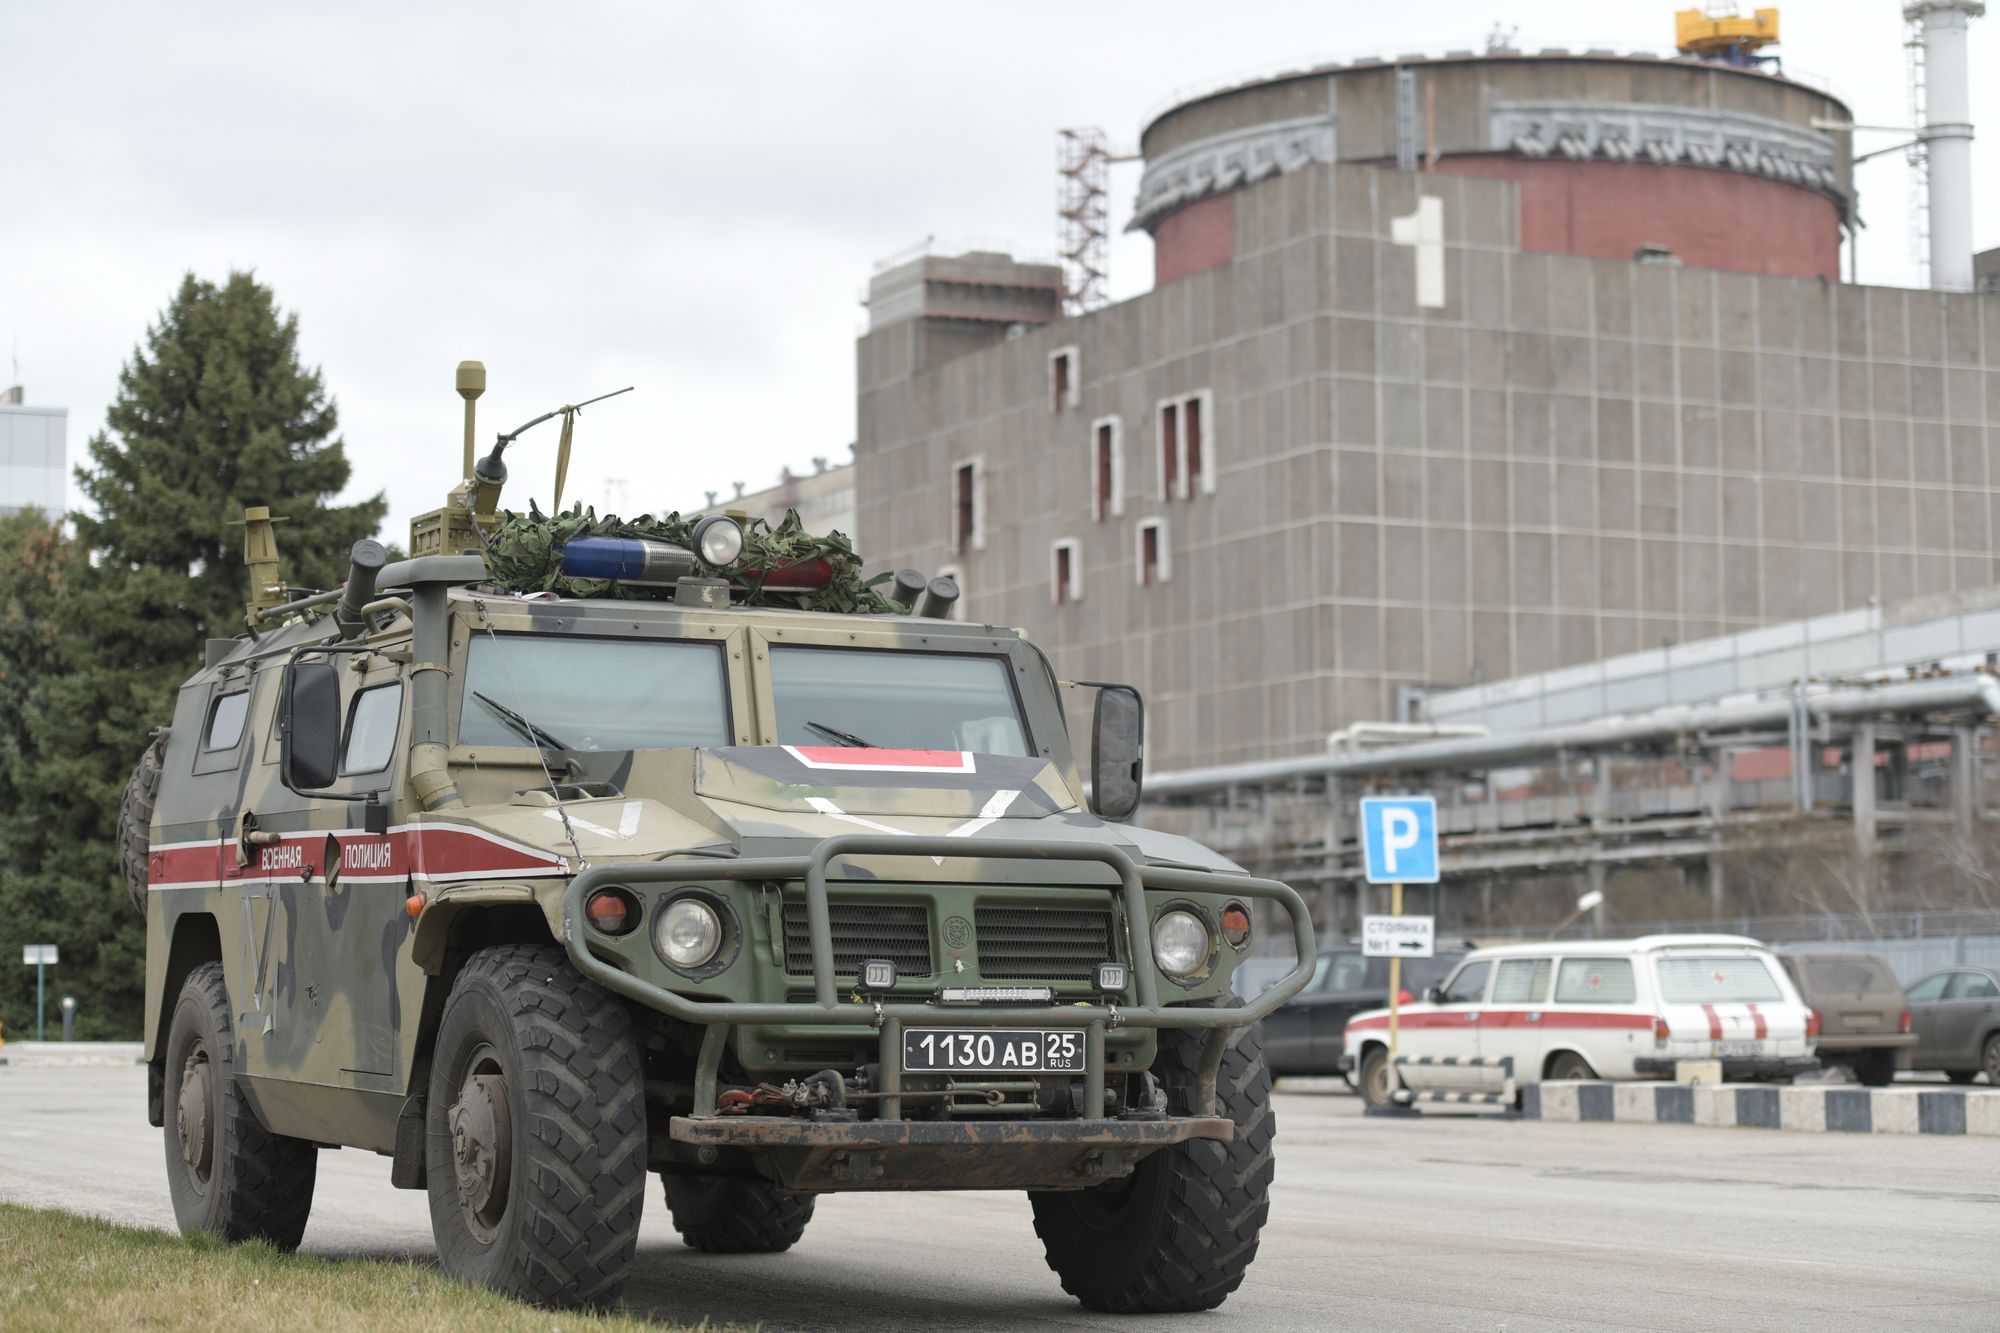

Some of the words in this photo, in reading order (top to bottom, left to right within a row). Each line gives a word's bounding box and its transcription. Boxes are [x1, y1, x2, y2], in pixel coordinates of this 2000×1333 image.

[1391, 196, 1445, 308] 1
[1382, 808, 1419, 873] P
[262, 846, 302, 870] ВОЕННАЯ
[345, 842, 391, 869] ПОЛИЦИЯ
[1368, 922, 1428, 933] СТОЯНКА
[920, 1034, 995, 1066] 1130
[1047, 1034, 1076, 1058] 25
[1050, 1059, 1071, 1068] RUS
